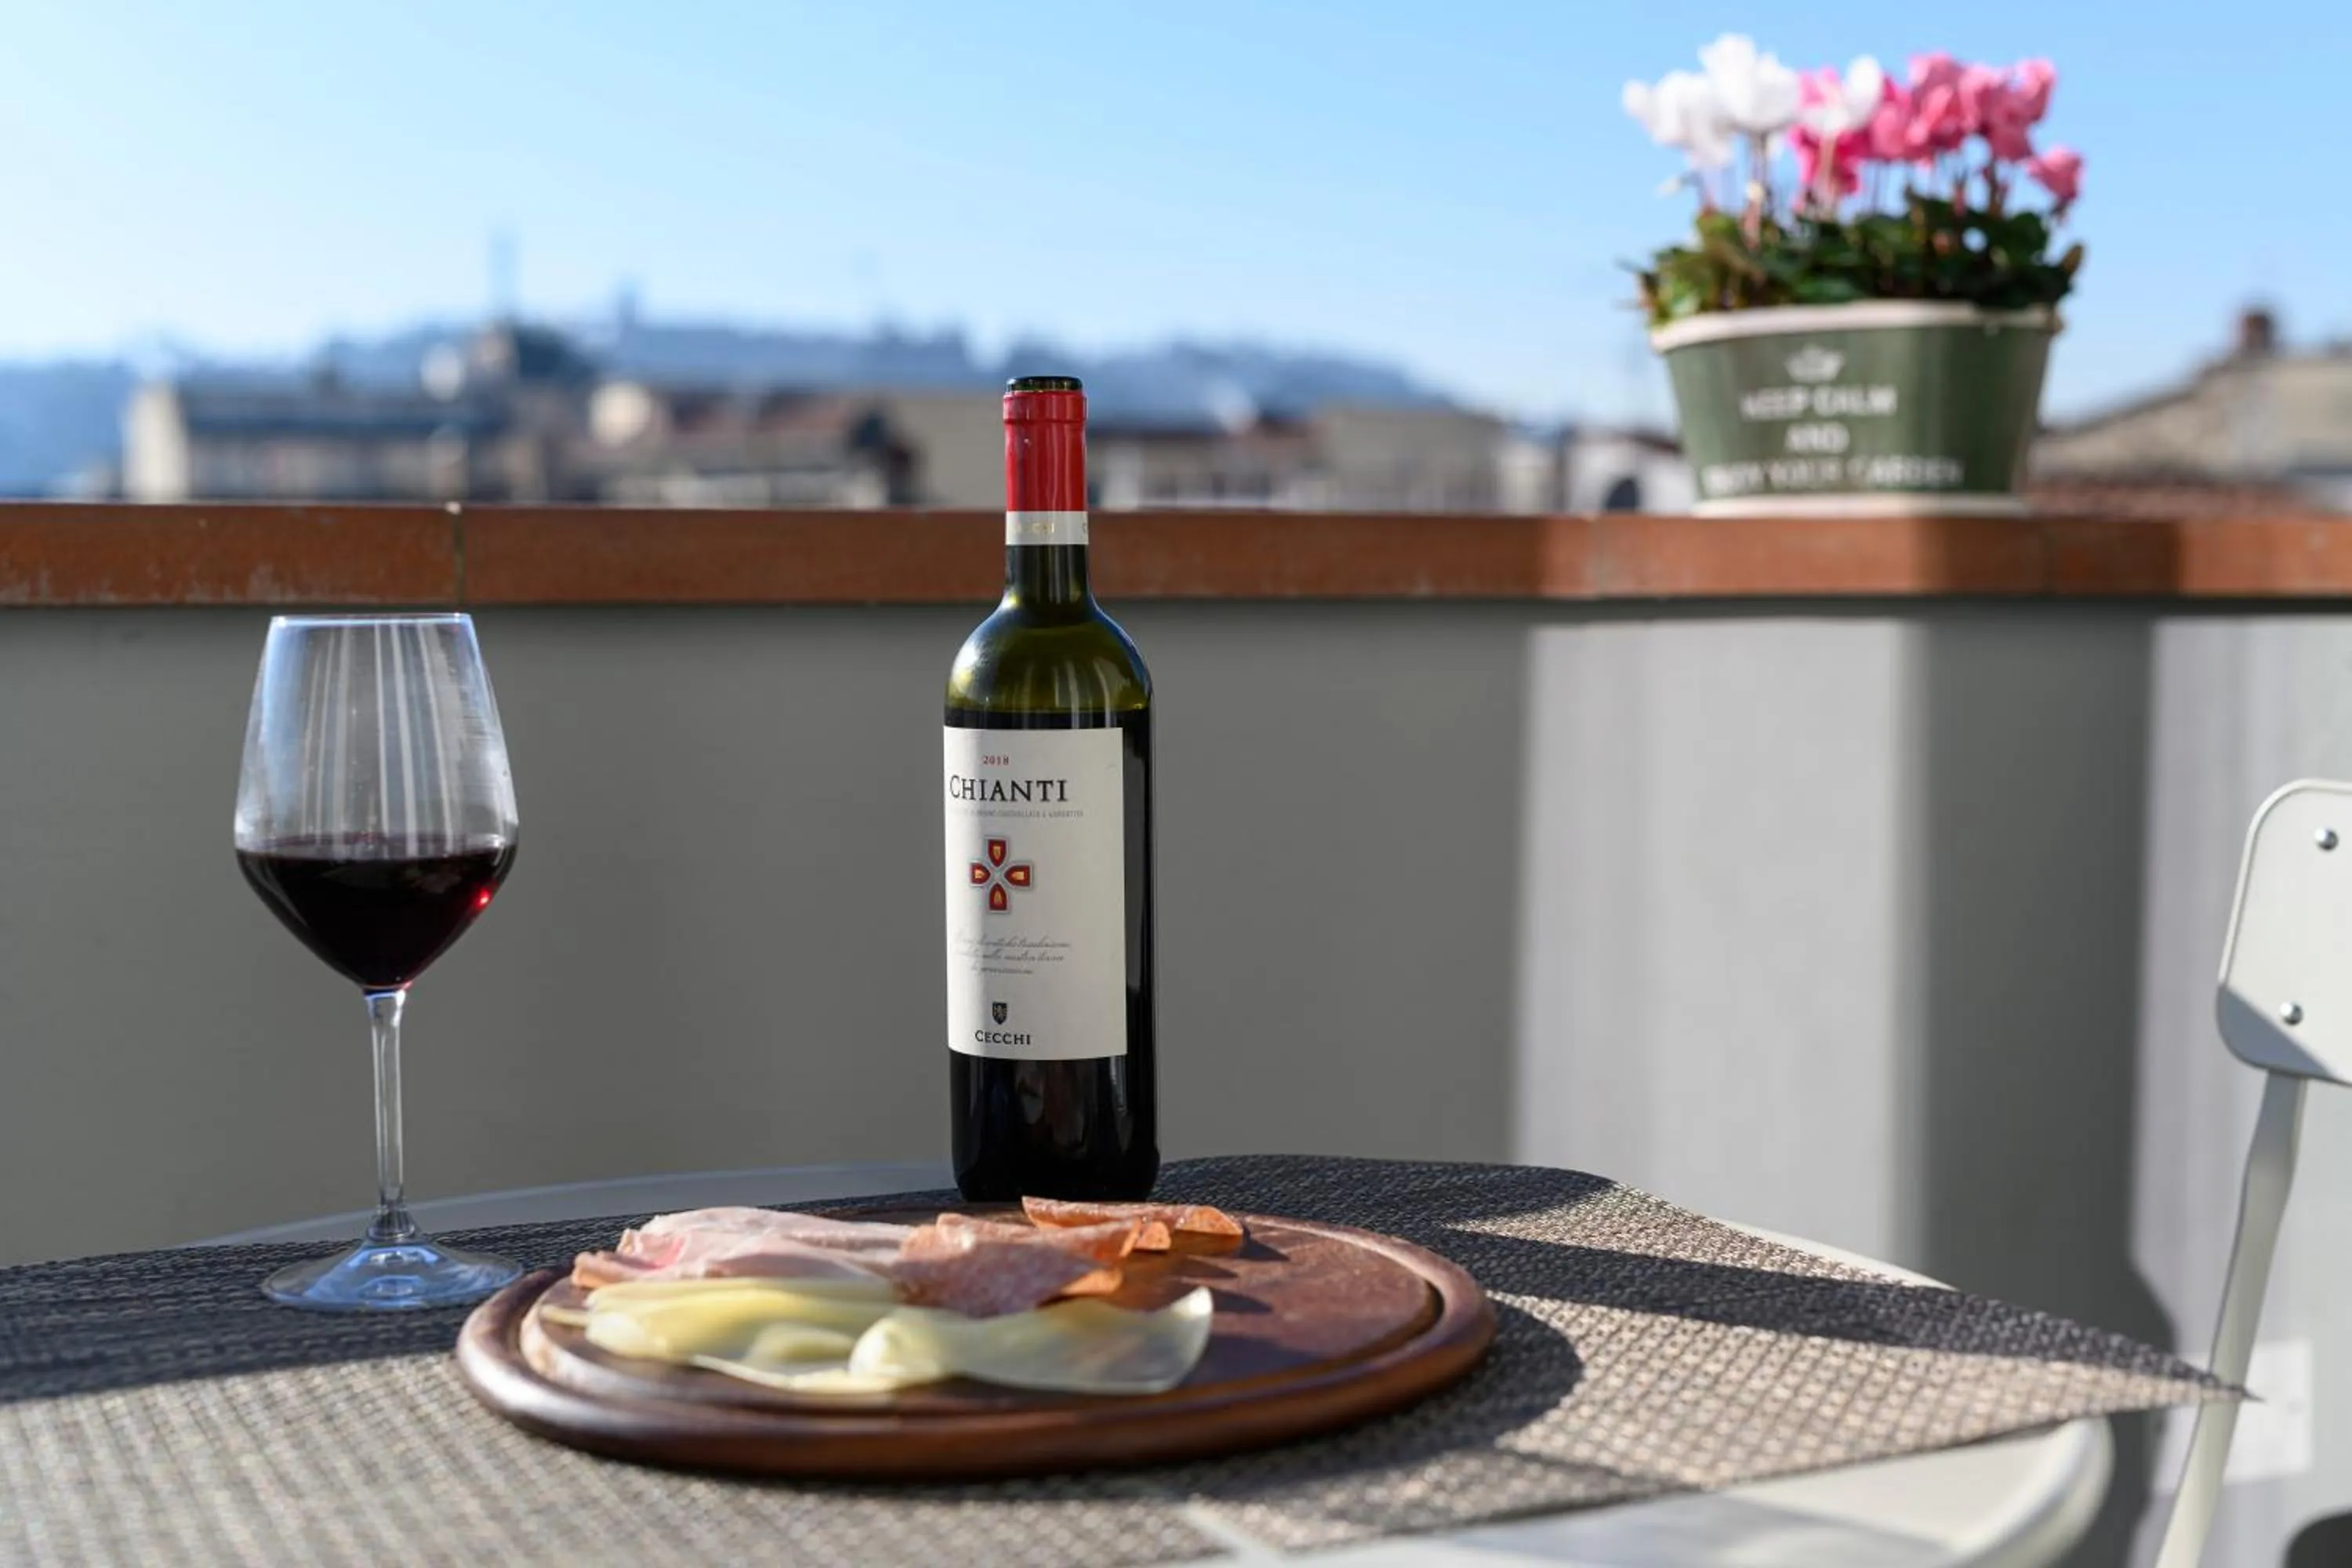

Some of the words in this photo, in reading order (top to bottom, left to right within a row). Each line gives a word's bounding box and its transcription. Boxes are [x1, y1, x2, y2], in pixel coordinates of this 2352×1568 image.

[982, 755, 1010, 766] 2018
[949, 775, 1068, 802] CHIANTI
[975, 1029, 1031, 1046] CECCHI
